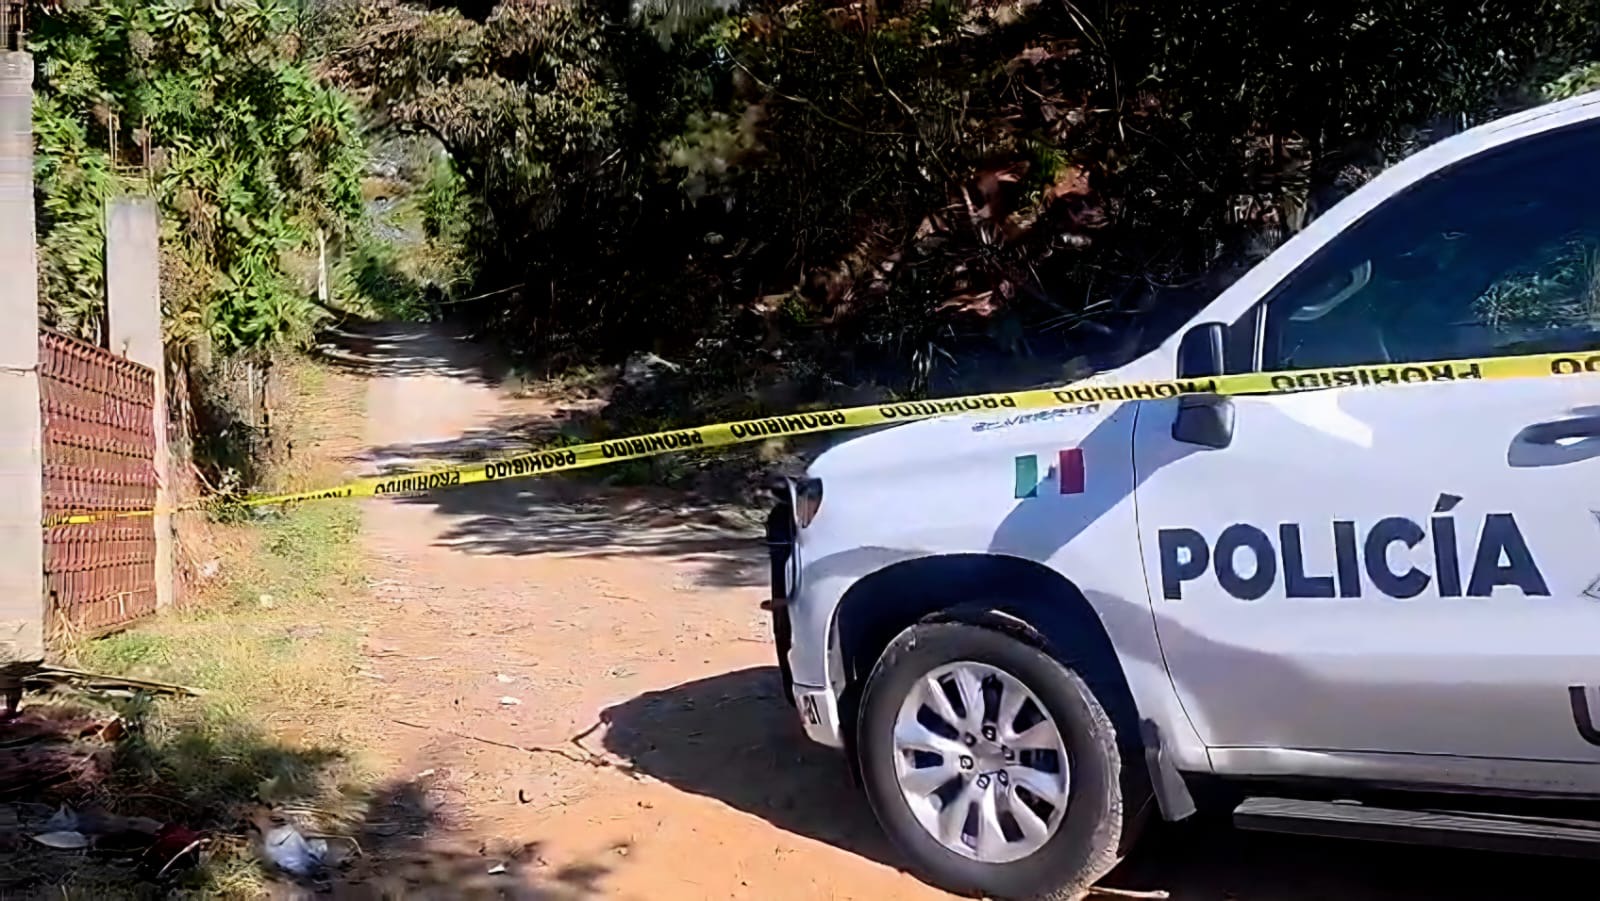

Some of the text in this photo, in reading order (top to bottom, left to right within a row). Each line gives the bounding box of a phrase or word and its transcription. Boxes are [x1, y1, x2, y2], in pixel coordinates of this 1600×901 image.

[1271, 362, 1482, 390] PROHIBIDO
[730, 410, 846, 439] PROHIBIDO
[601, 430, 703, 458] PROHIBIDO
[485, 450, 576, 479] PROHIBIDO
[1158, 492, 1551, 600] POLICÍA
